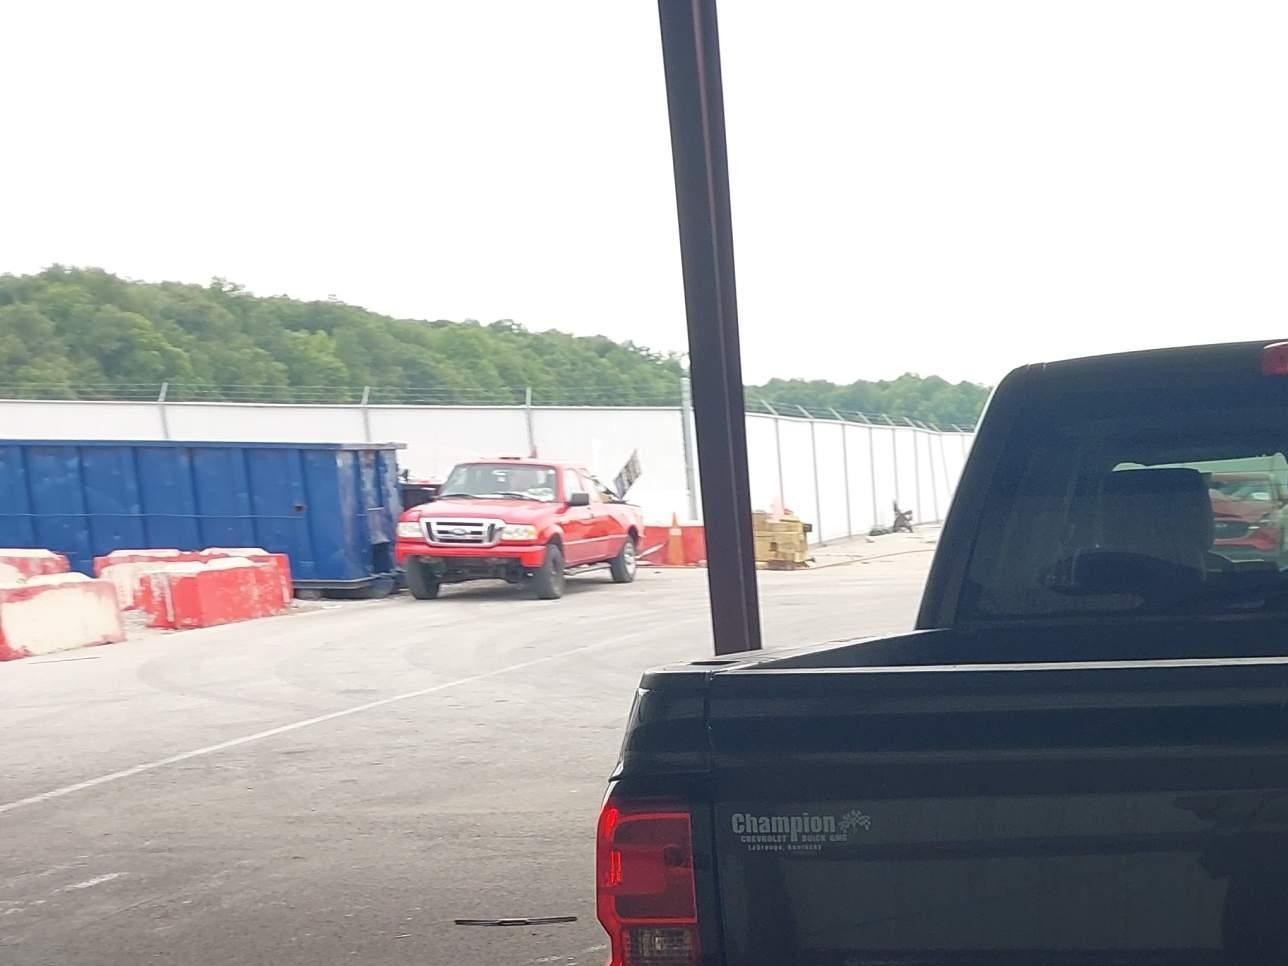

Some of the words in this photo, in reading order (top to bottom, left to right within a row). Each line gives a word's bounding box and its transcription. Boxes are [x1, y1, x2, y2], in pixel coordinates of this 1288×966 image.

[731, 812, 836, 842] Champion
[740, 834, 787, 843] CHEVROLET
[801, 834, 826, 842] BUICK
